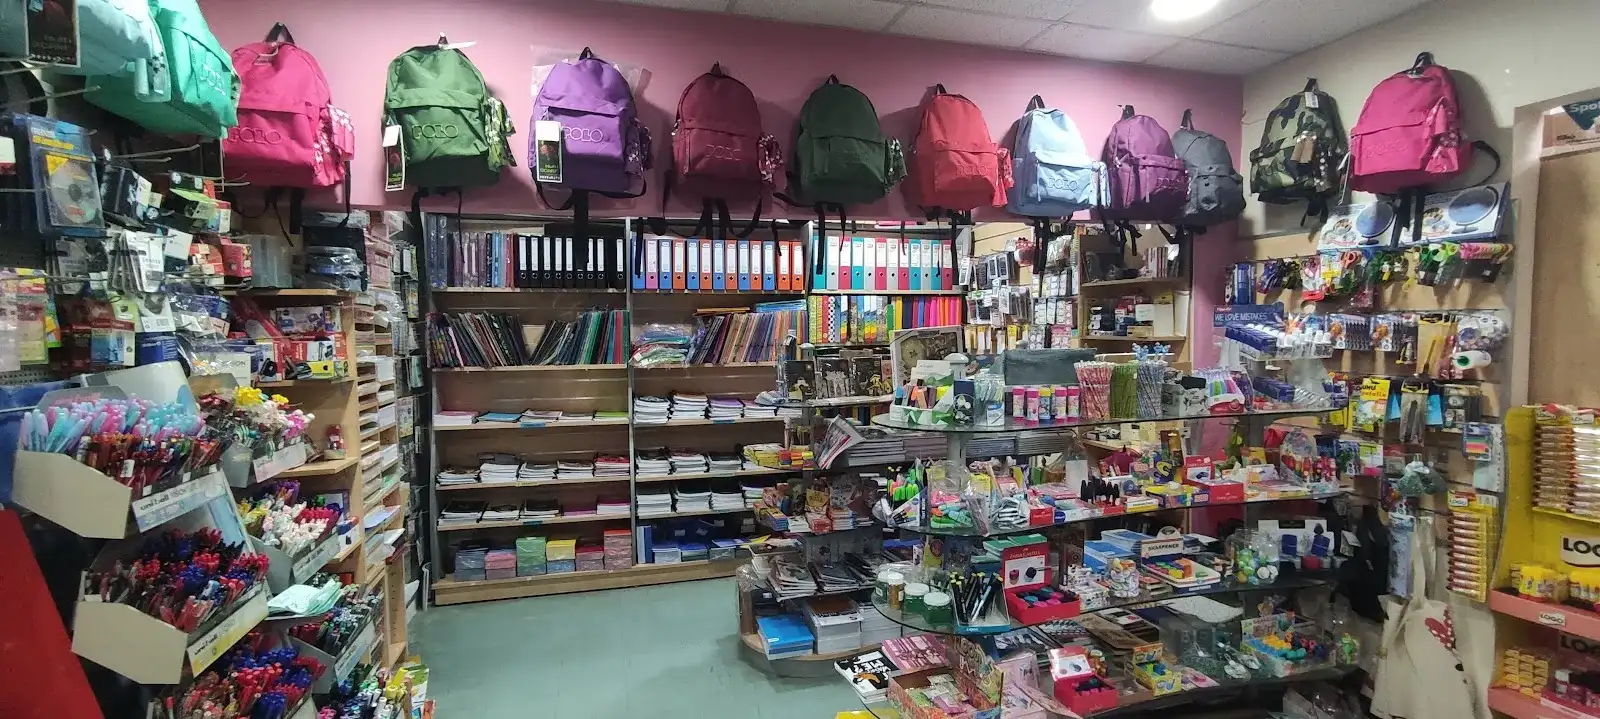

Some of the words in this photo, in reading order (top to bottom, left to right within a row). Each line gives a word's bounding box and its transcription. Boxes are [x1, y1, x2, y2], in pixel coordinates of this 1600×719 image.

[1570, 100, 1600, 114] Spo
[228, 126, 282, 145] POLO
[411, 124, 459, 140] POLO
[561, 126, 603, 143] POLO
[1047, 177, 1077, 192] POLO
[1214, 313, 1224, 321] WE
[1225, 312, 1240, 321] LOVE
[1240, 312, 1268, 321] MISTAKES
[1148, 542, 1180, 552] SHARPENER
[1540, 613, 1564, 624] LOGO
